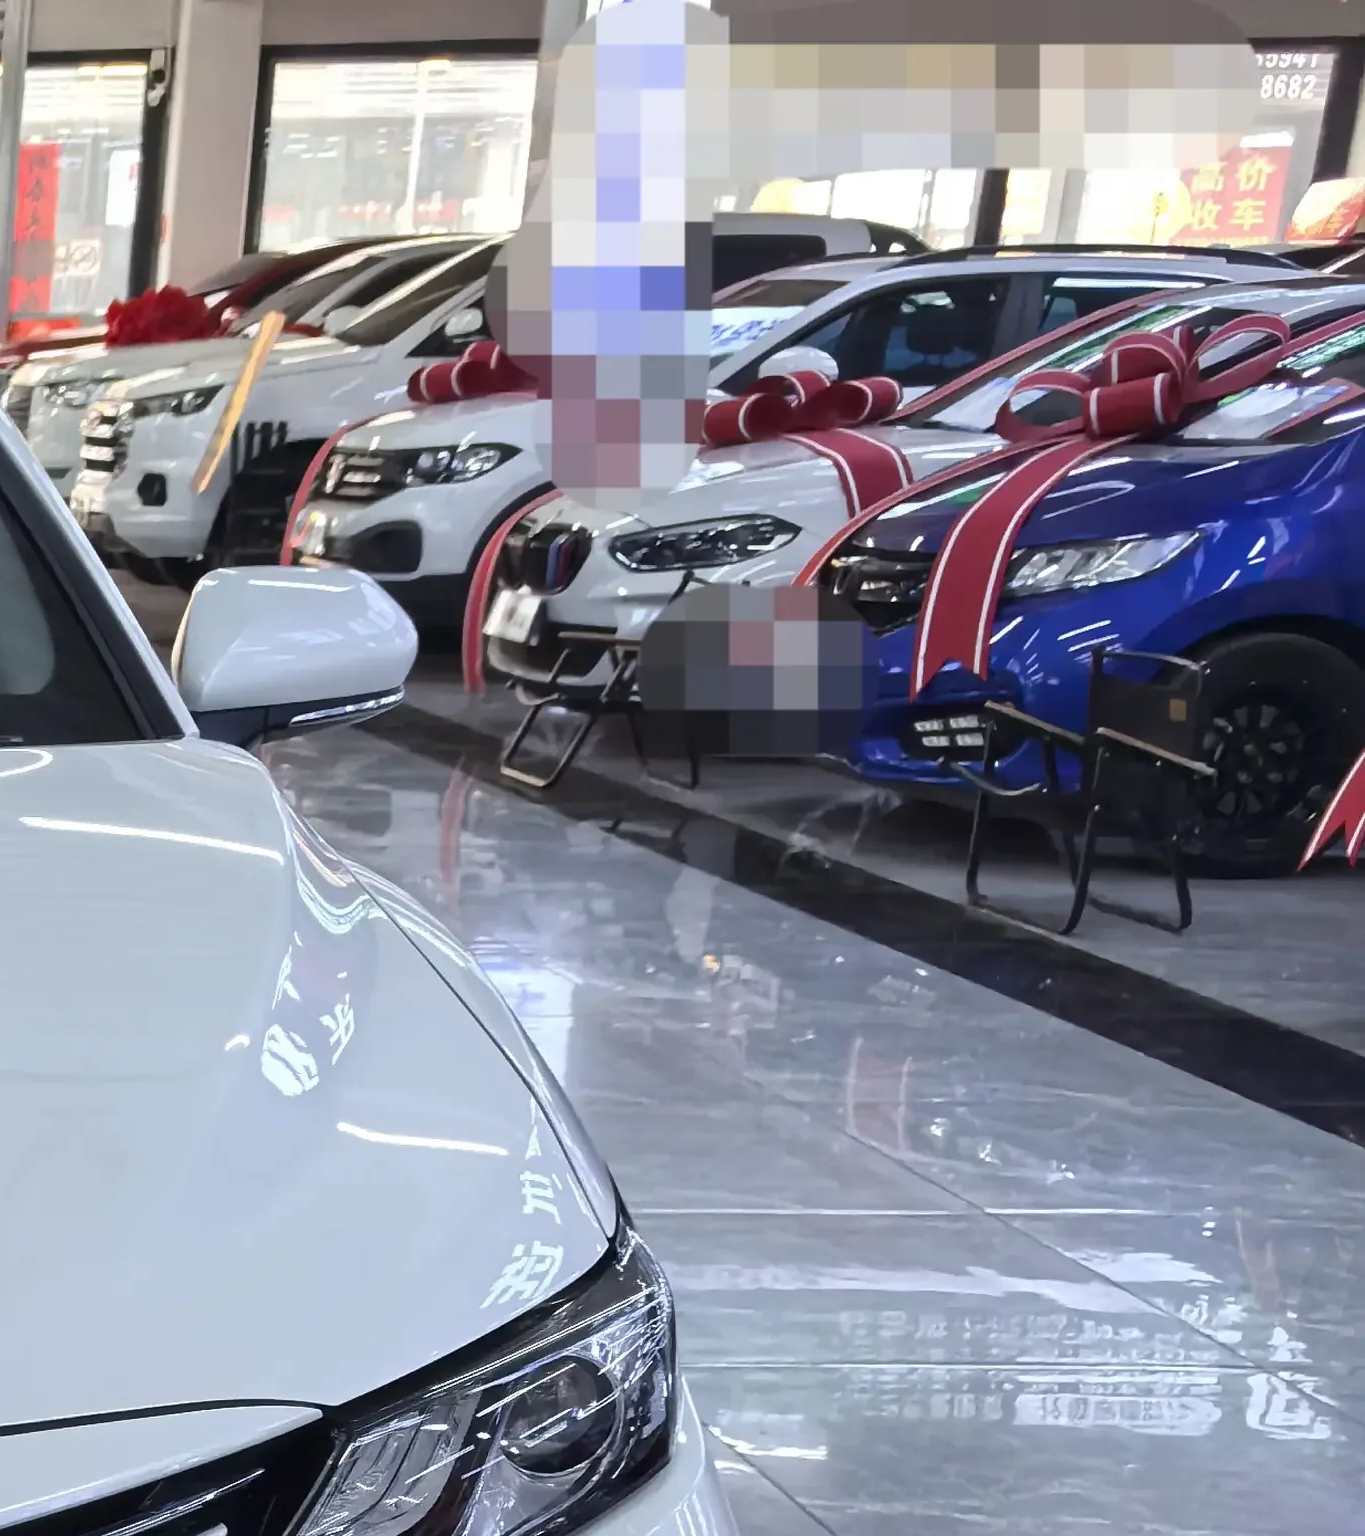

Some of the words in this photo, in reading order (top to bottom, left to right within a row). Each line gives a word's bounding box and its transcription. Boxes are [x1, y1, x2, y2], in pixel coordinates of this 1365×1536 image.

[1260, 73, 1317, 99] 8682
[1190, 157, 1277, 192] 高价
[1190, 197, 1266, 232] 收车
